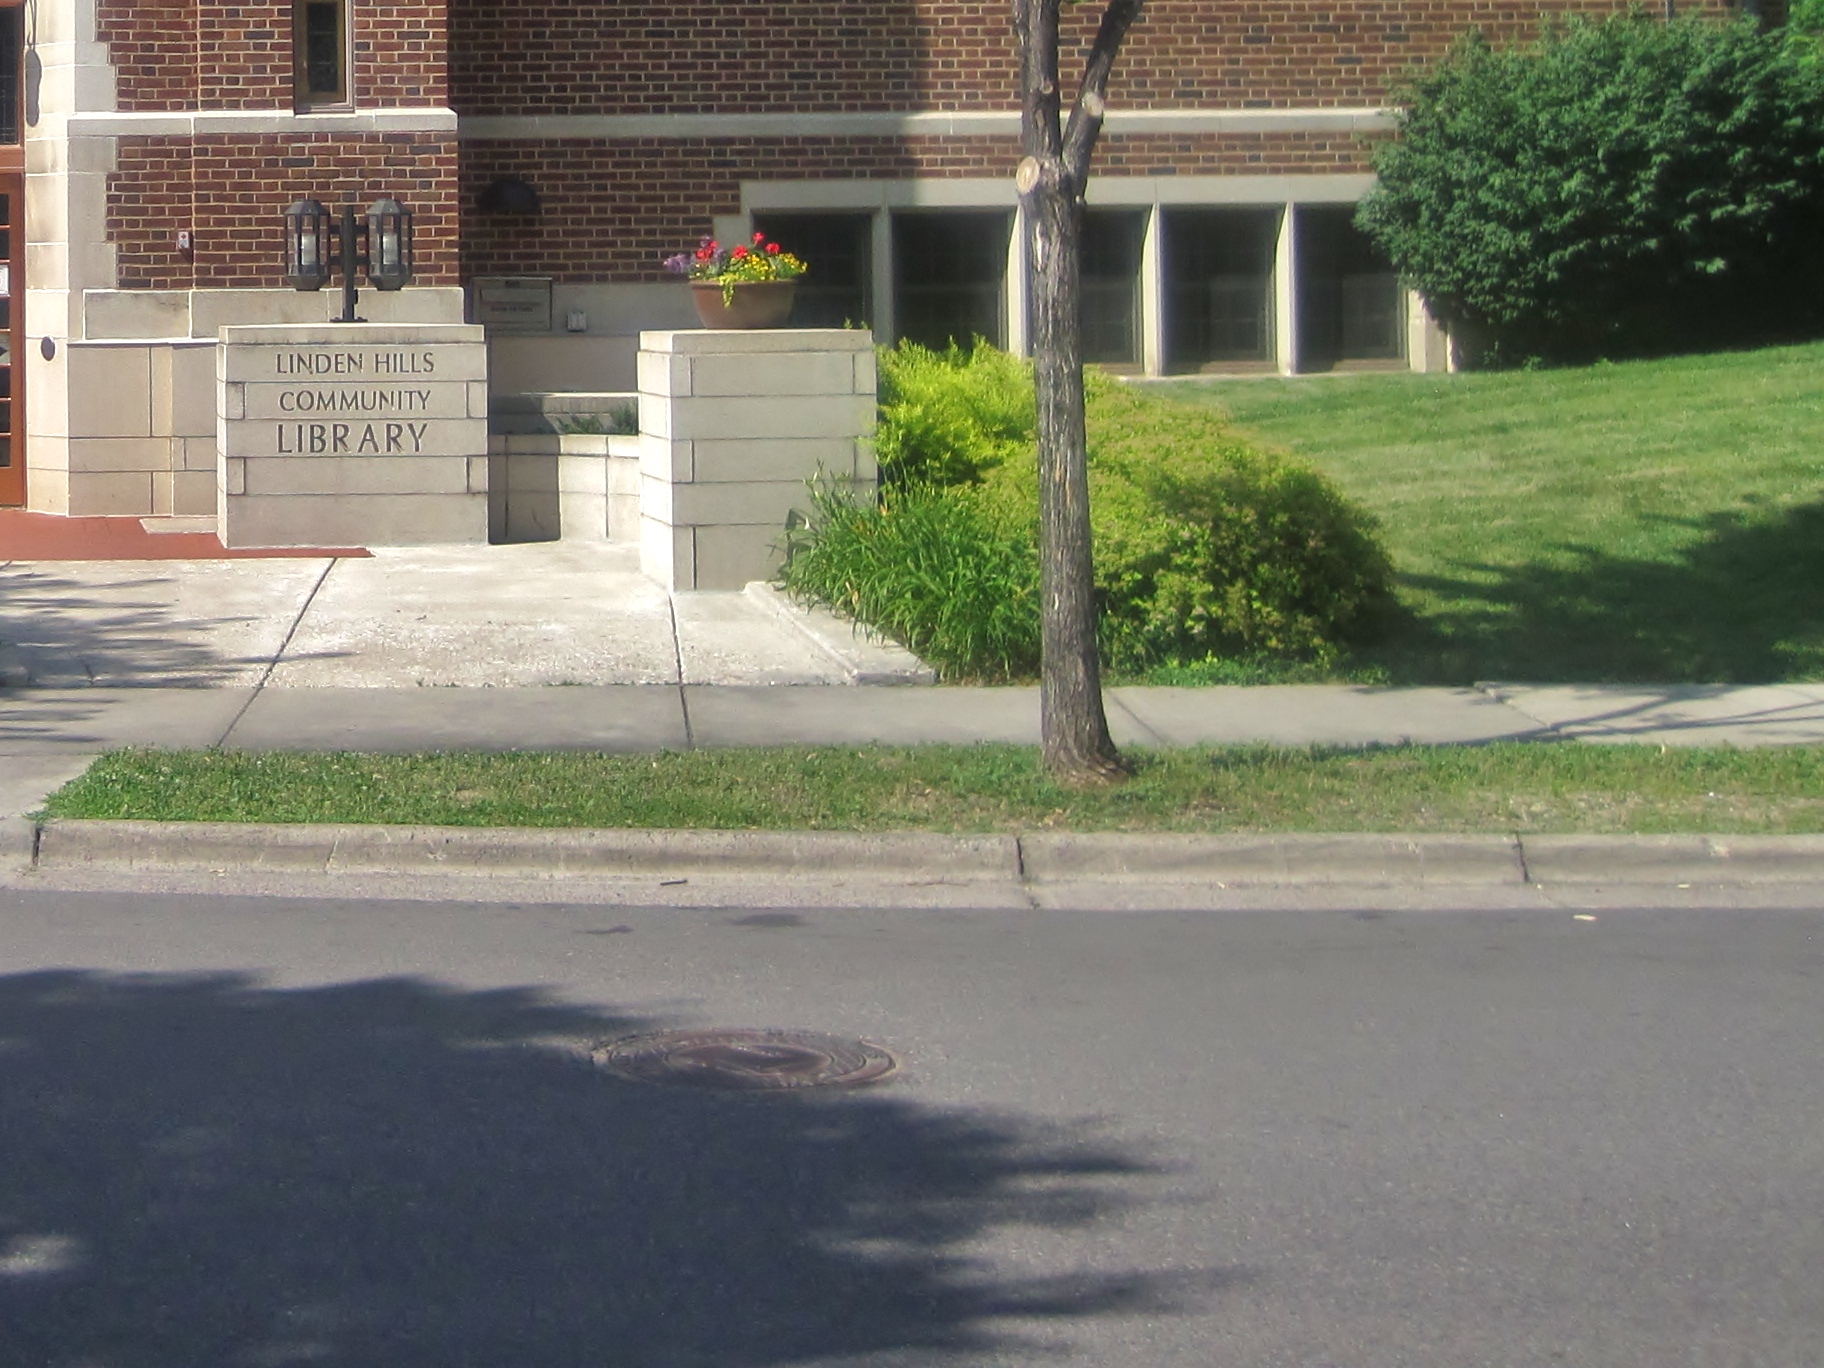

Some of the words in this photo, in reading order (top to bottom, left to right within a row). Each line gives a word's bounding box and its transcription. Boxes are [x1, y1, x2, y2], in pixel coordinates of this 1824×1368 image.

[276, 353, 363, 375] LINDEN
[375, 351, 435, 374] HILLS
[279, 389, 431, 412] COMMUNITY
[277, 422, 428, 454] LIBRARY
